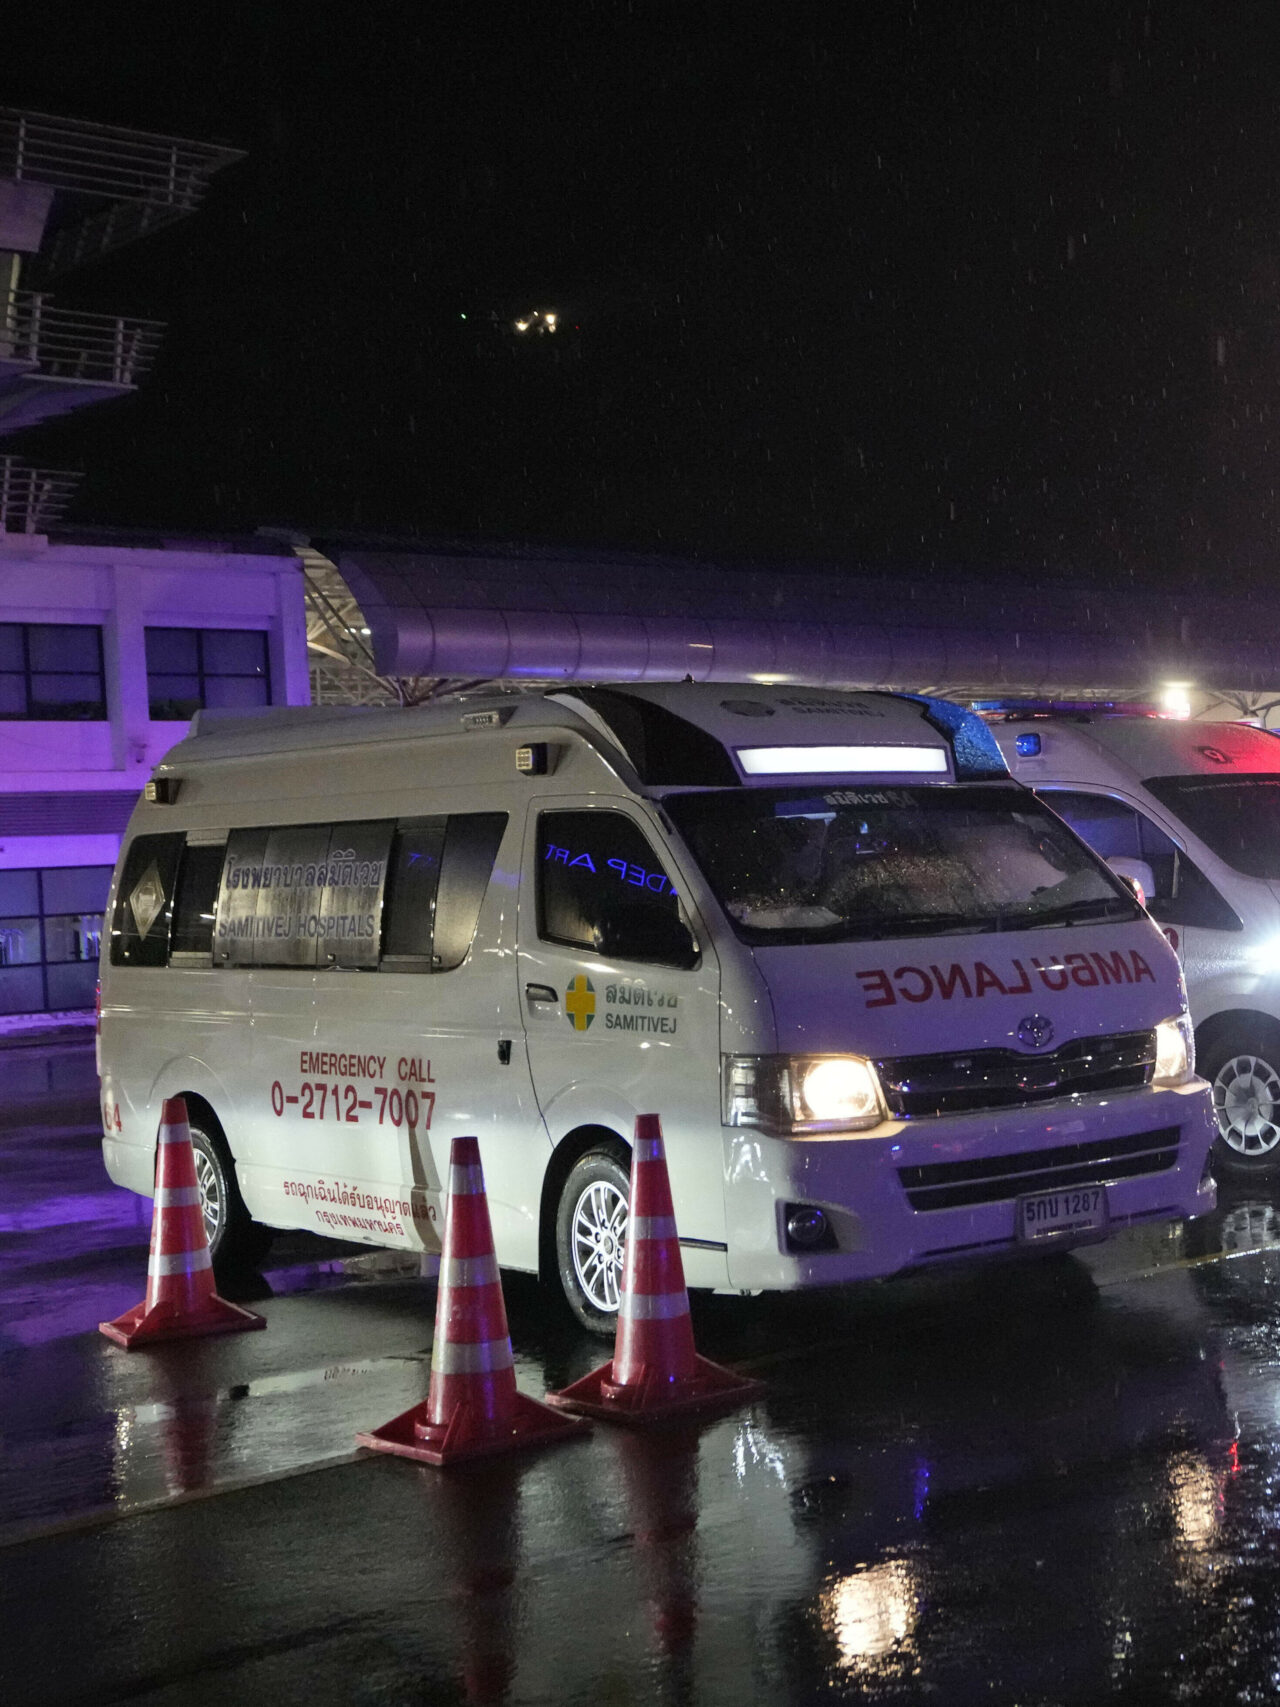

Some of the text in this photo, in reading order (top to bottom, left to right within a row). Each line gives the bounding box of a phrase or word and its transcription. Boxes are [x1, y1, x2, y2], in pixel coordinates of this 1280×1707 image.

[218, 914, 376, 939] SAMITIVEJ HOSPITALS
[605, 1013, 677, 1034] SAMITIVEJ
[300, 1051, 436, 1084] EMERGENCY CALL
[271, 1080, 436, 1131] 0-2712-7007
[1026, 1190, 1100, 1222] 5กบ 1287
